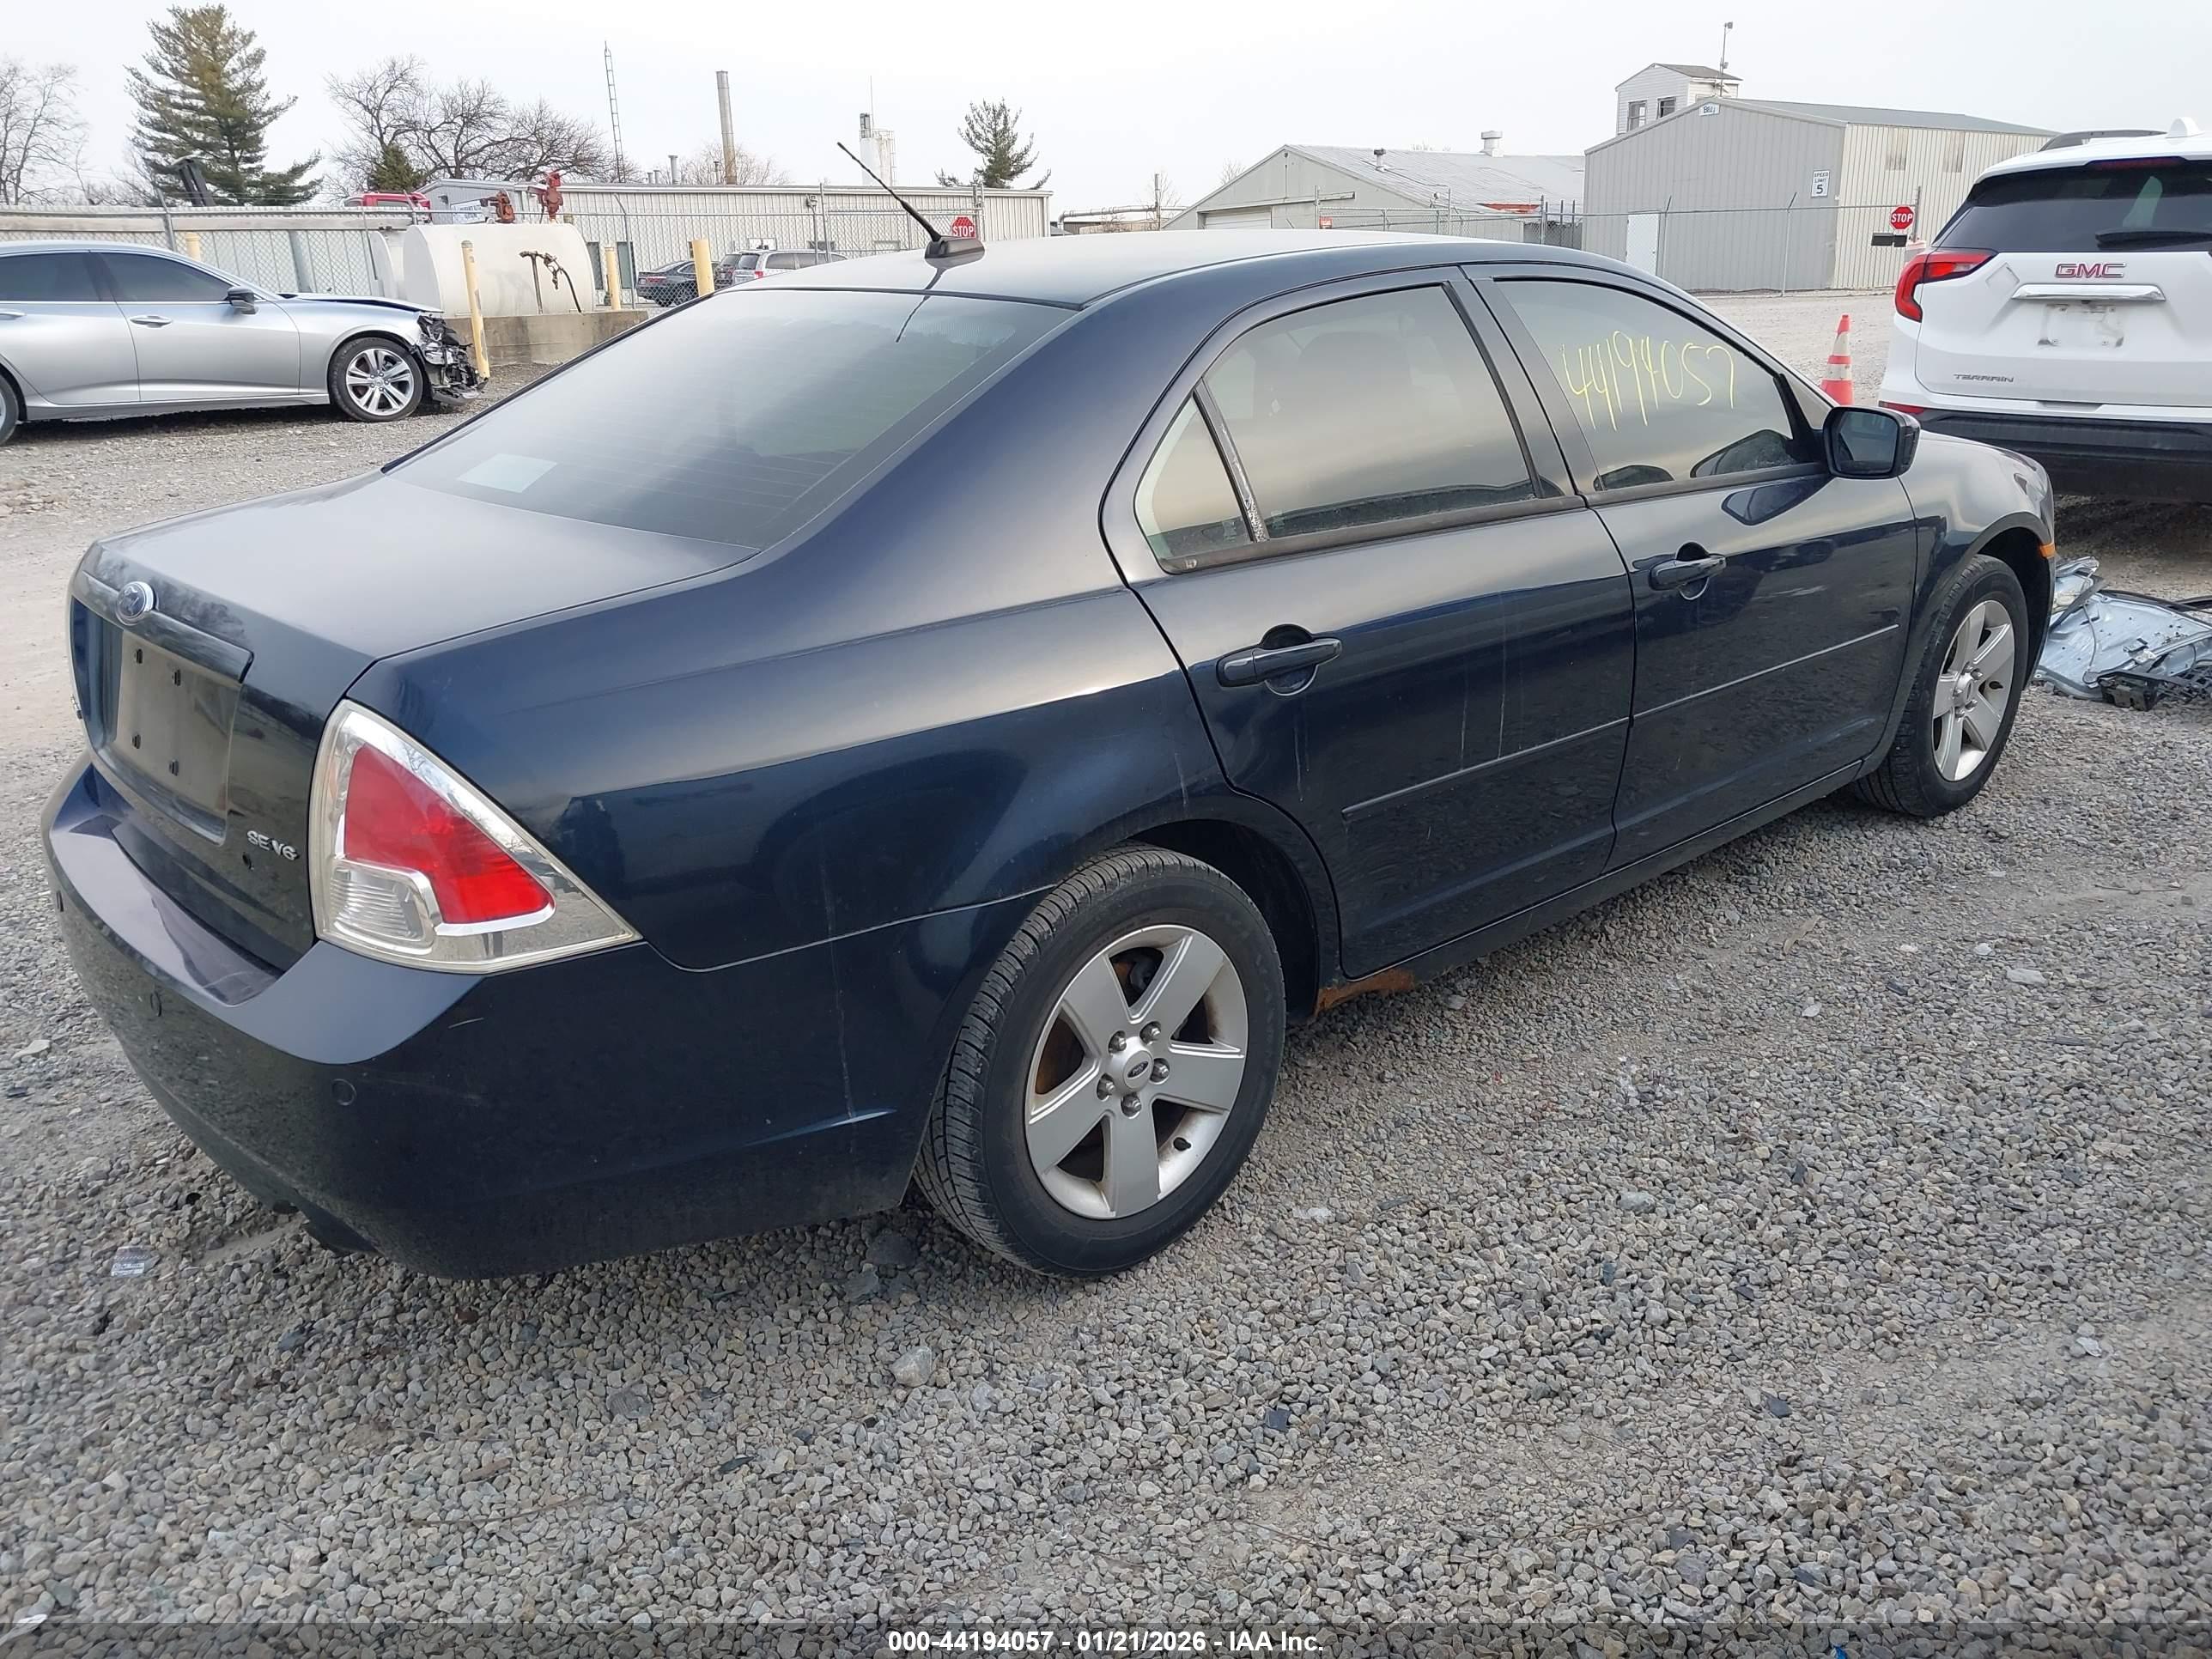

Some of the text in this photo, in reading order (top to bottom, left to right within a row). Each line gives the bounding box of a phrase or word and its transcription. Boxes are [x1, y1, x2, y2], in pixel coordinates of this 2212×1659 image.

[1816, 184, 1824, 194] 5
[1891, 213, 1913, 223] STOP
[952, 225, 974, 237] STOP
[2055, 262, 2126, 279] GMC
[1559, 331, 1735, 431] 44194057
[1954, 373, 2014, 383] TERRAIN
[246, 830, 298, 860] SE V6
